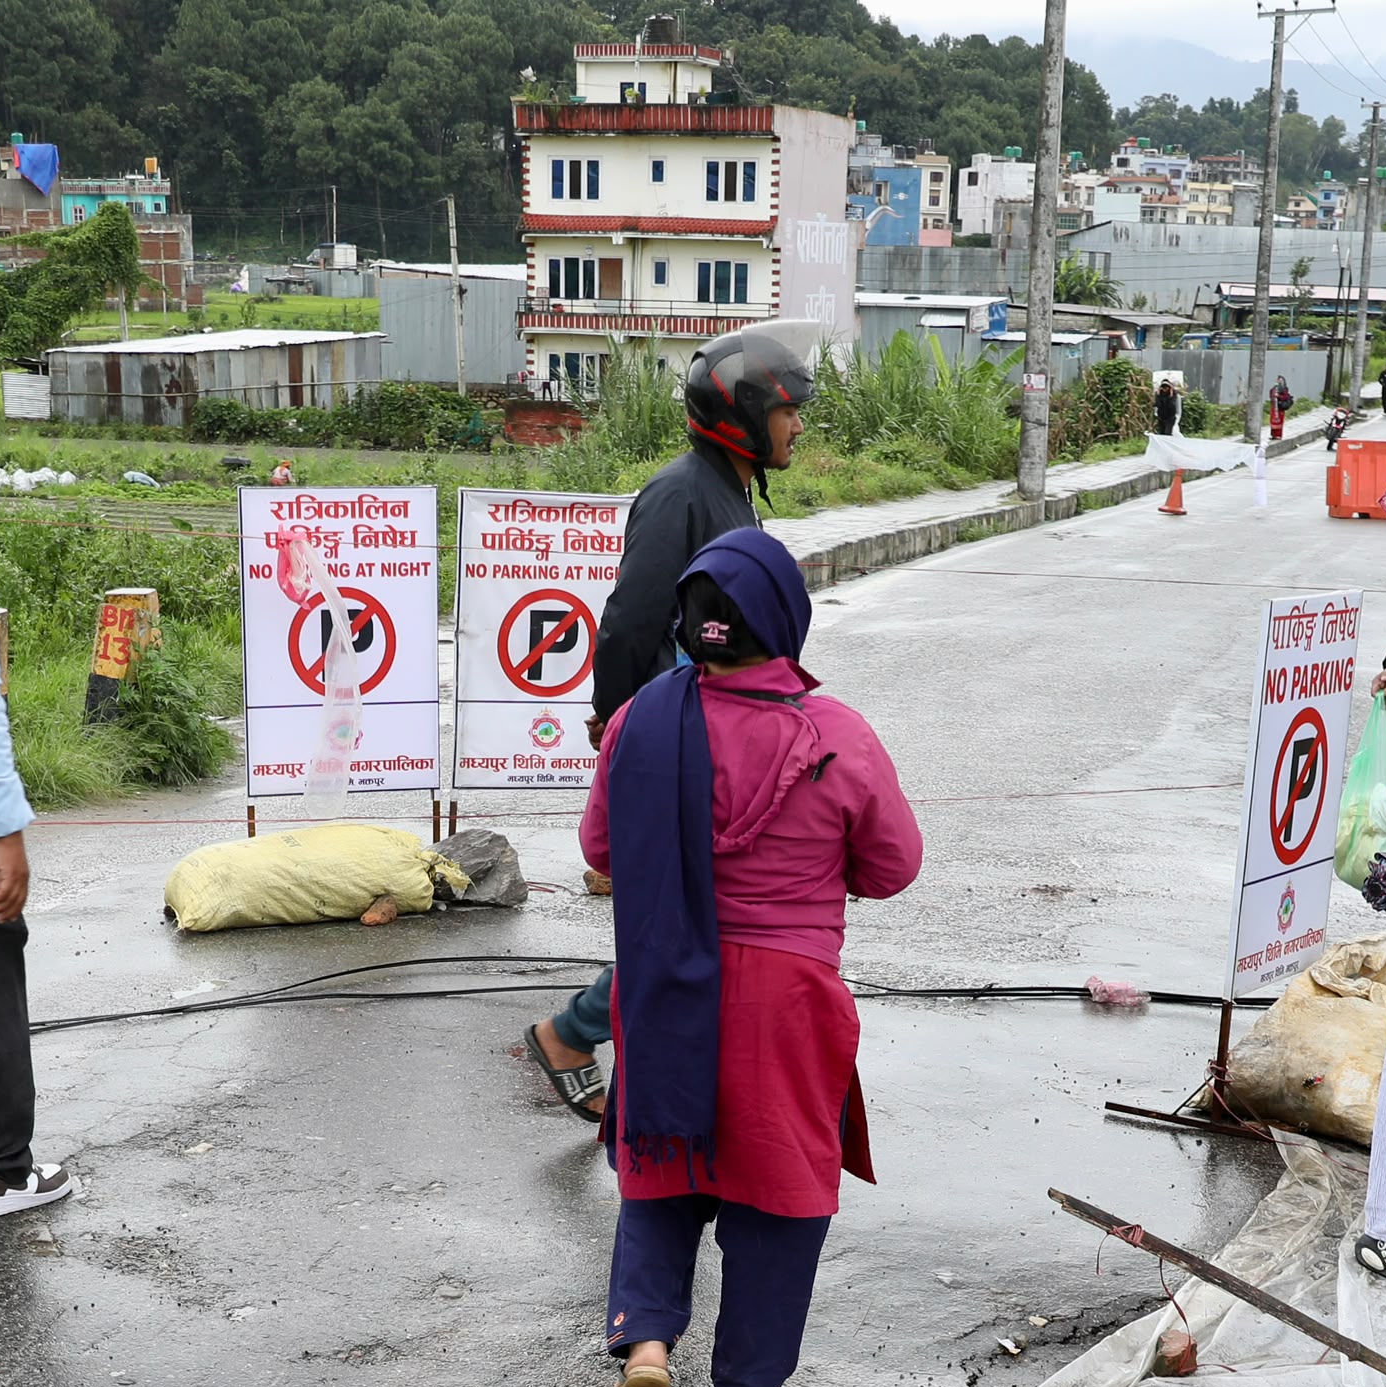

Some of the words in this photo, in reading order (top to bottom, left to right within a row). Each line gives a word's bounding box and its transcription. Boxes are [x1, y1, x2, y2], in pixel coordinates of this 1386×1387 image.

[269, 494, 411, 521] रात्रिकालिन
[488, 499, 618, 525] रात्रिकालिन
[352, 524, 418, 549] निषेध
[481, 527, 556, 562] पार्किङ्ग
[563, 528, 624, 553] निषेध
[249, 564, 273, 579] NO
[355, 563, 375, 577] AT
[381, 562, 431, 577] NIGHT
[465, 564, 487, 579] NO
[493, 564, 560, 581] PARKING
[564, 566, 584, 580] AT
[1320, 596, 1359, 645] निषेध
[98, 633, 131, 665] 13
[1264, 667, 1288, 705] NO
[1290, 657, 1354, 701] PARKING
[253, 763, 306, 779] मध्यपुर
[349, 755, 435, 773] नगरपालिका
[459, 757, 509, 773] मध्यपुर
[513, 754, 547, 770] थिमि
